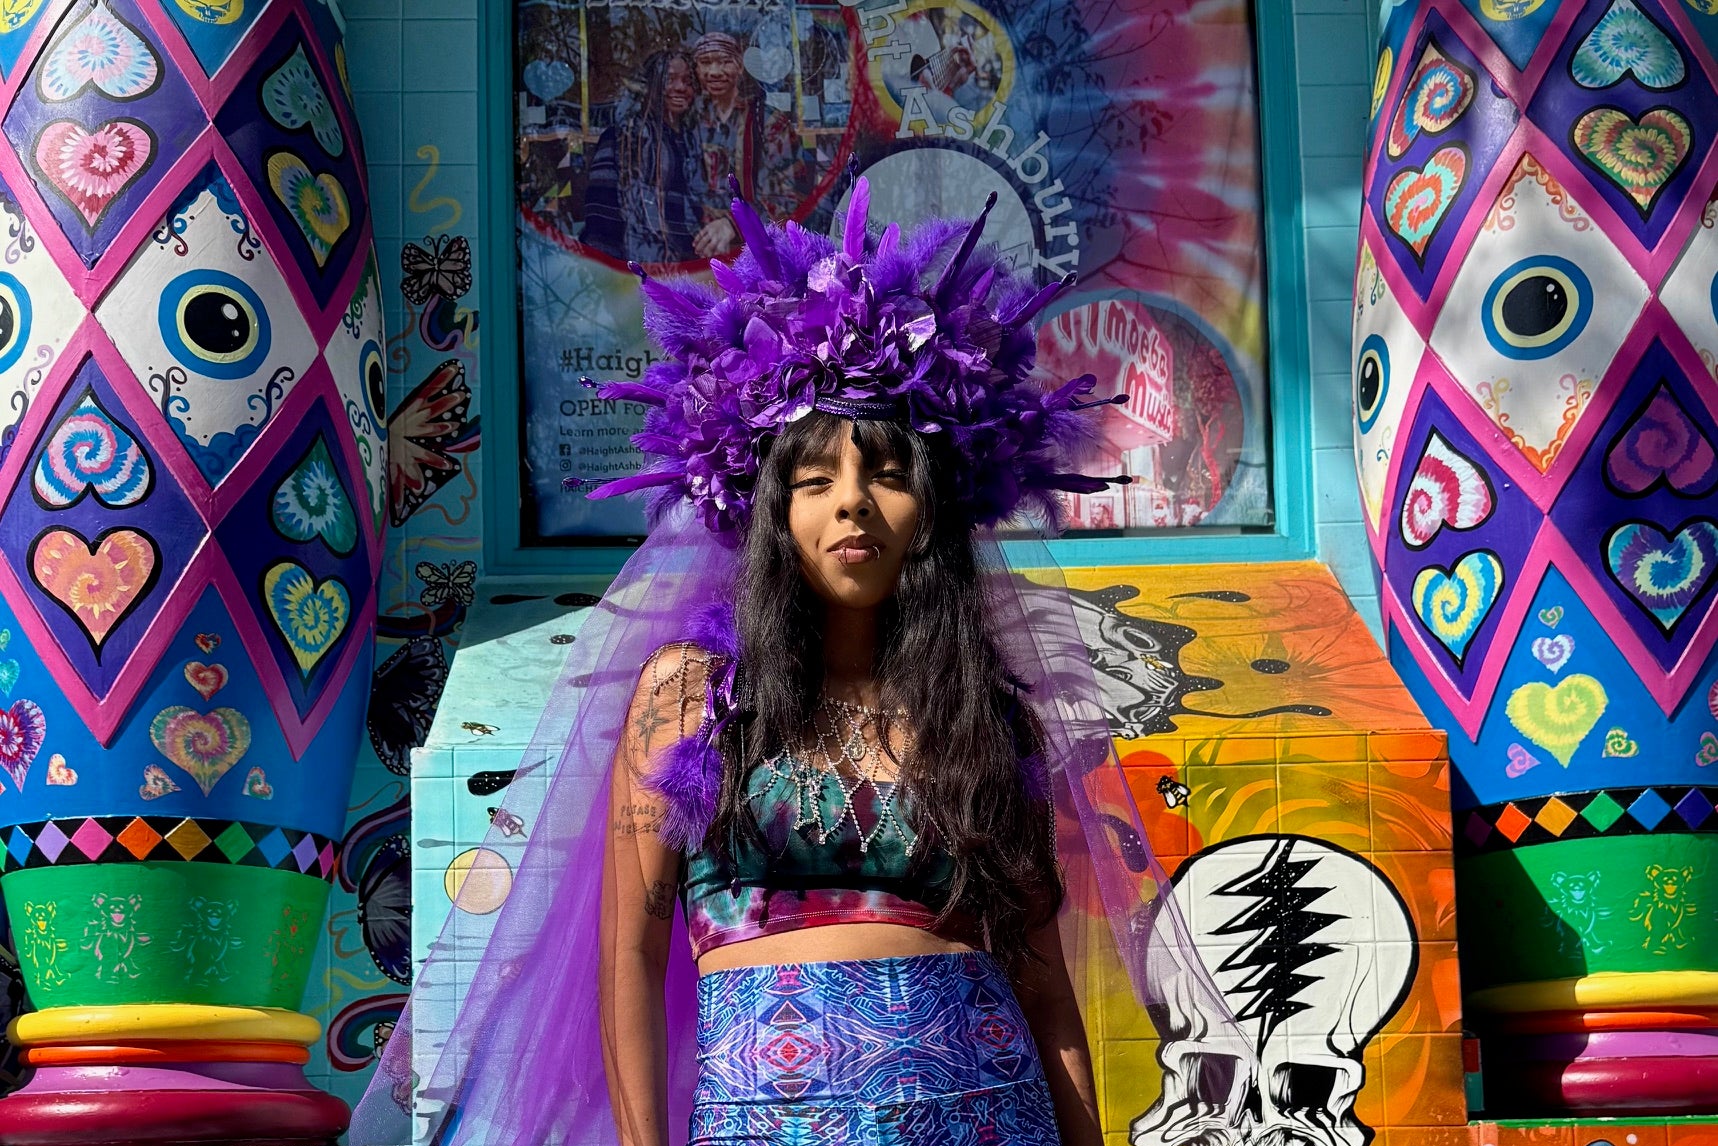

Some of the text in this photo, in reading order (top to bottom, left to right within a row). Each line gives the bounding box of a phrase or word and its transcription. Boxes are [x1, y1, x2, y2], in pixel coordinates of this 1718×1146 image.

[896, 86, 1080, 286] Ashbury
[560, 399, 617, 416] OPEN
[560, 426, 594, 437] Learn
[598, 427, 630, 436] more
